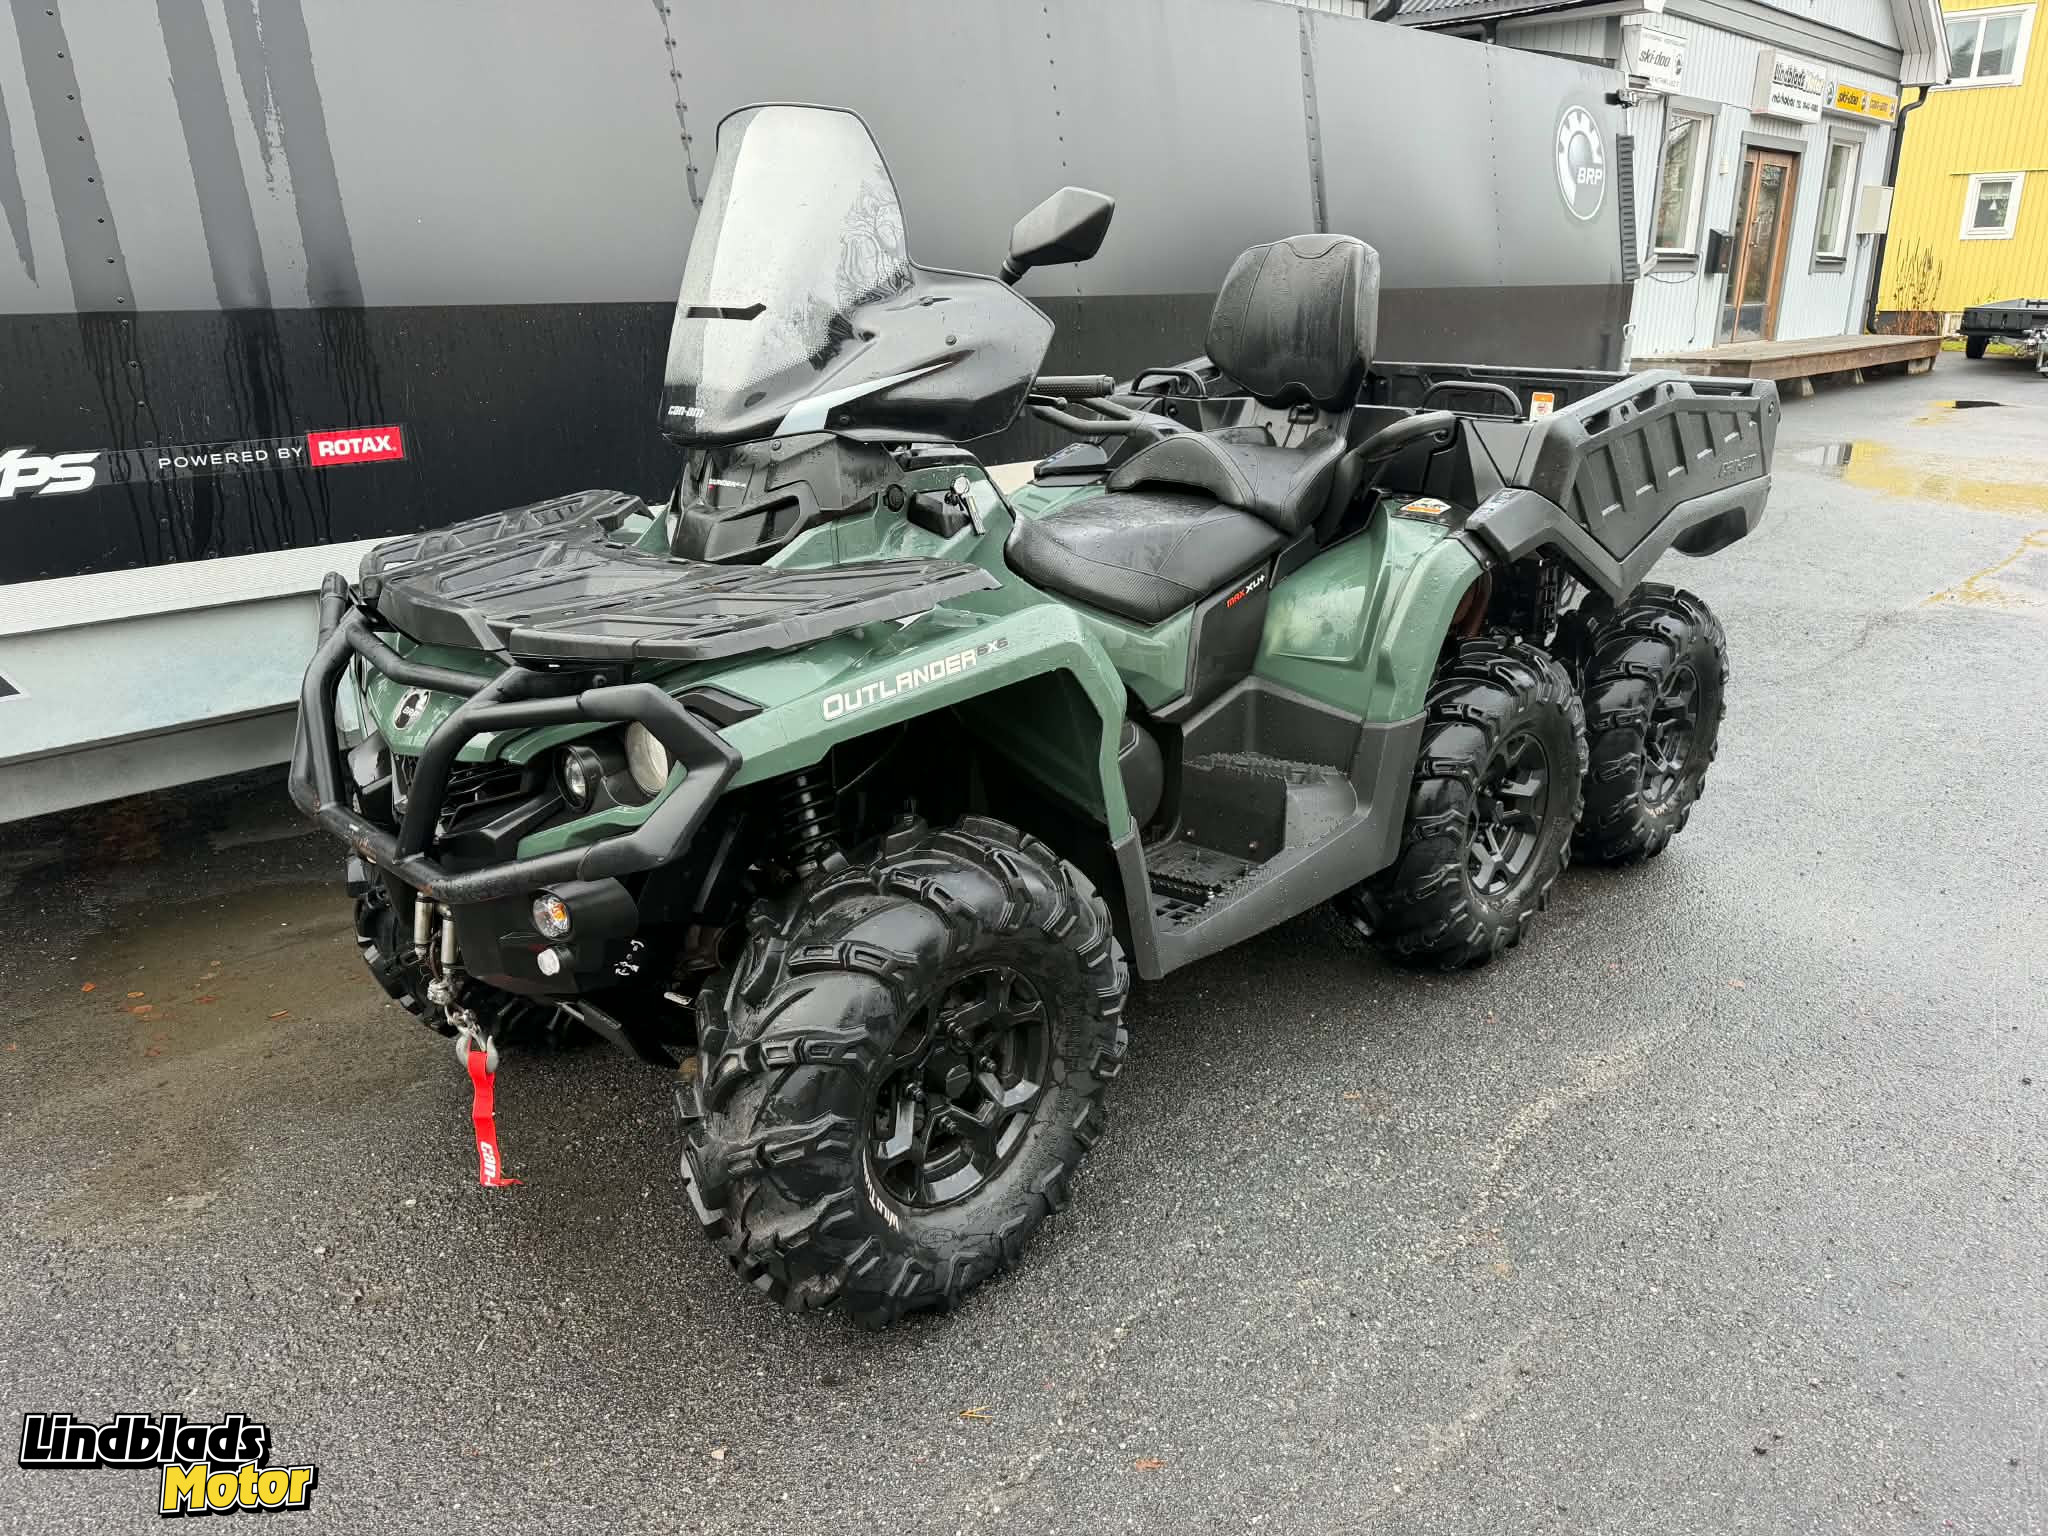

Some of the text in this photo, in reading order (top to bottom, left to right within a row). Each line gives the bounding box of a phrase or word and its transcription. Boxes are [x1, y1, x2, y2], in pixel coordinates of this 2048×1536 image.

[1577, 167, 1602, 185] BRP
[0, 435, 394, 498] PS POWERED BY ROTAX
[822, 649, 977, 721] OUTLANDER
